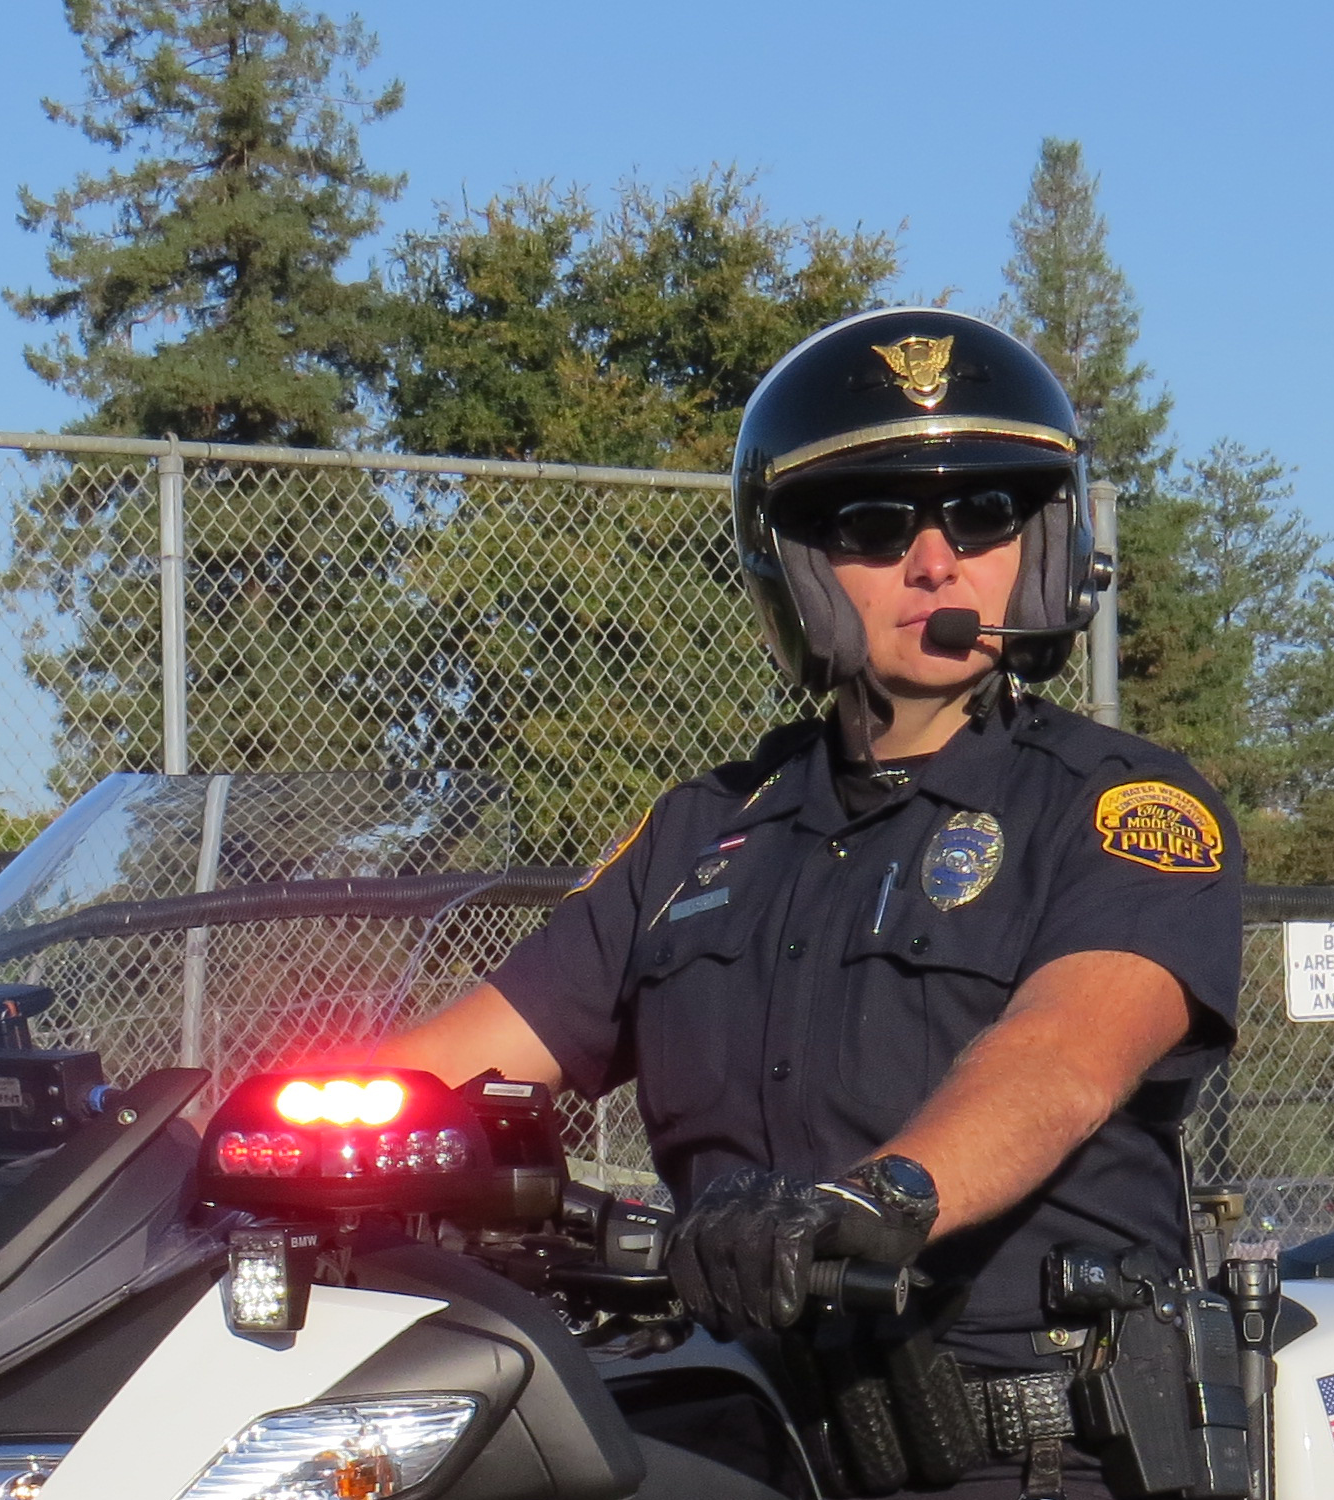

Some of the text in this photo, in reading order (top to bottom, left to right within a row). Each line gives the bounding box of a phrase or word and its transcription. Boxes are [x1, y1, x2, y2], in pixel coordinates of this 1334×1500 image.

[1127, 817, 1196, 839] MODESTO
[1120, 831, 1205, 864] POLICE
[1309, 974, 1325, 991] IN
[290, 1235, 318, 1249] BMW
